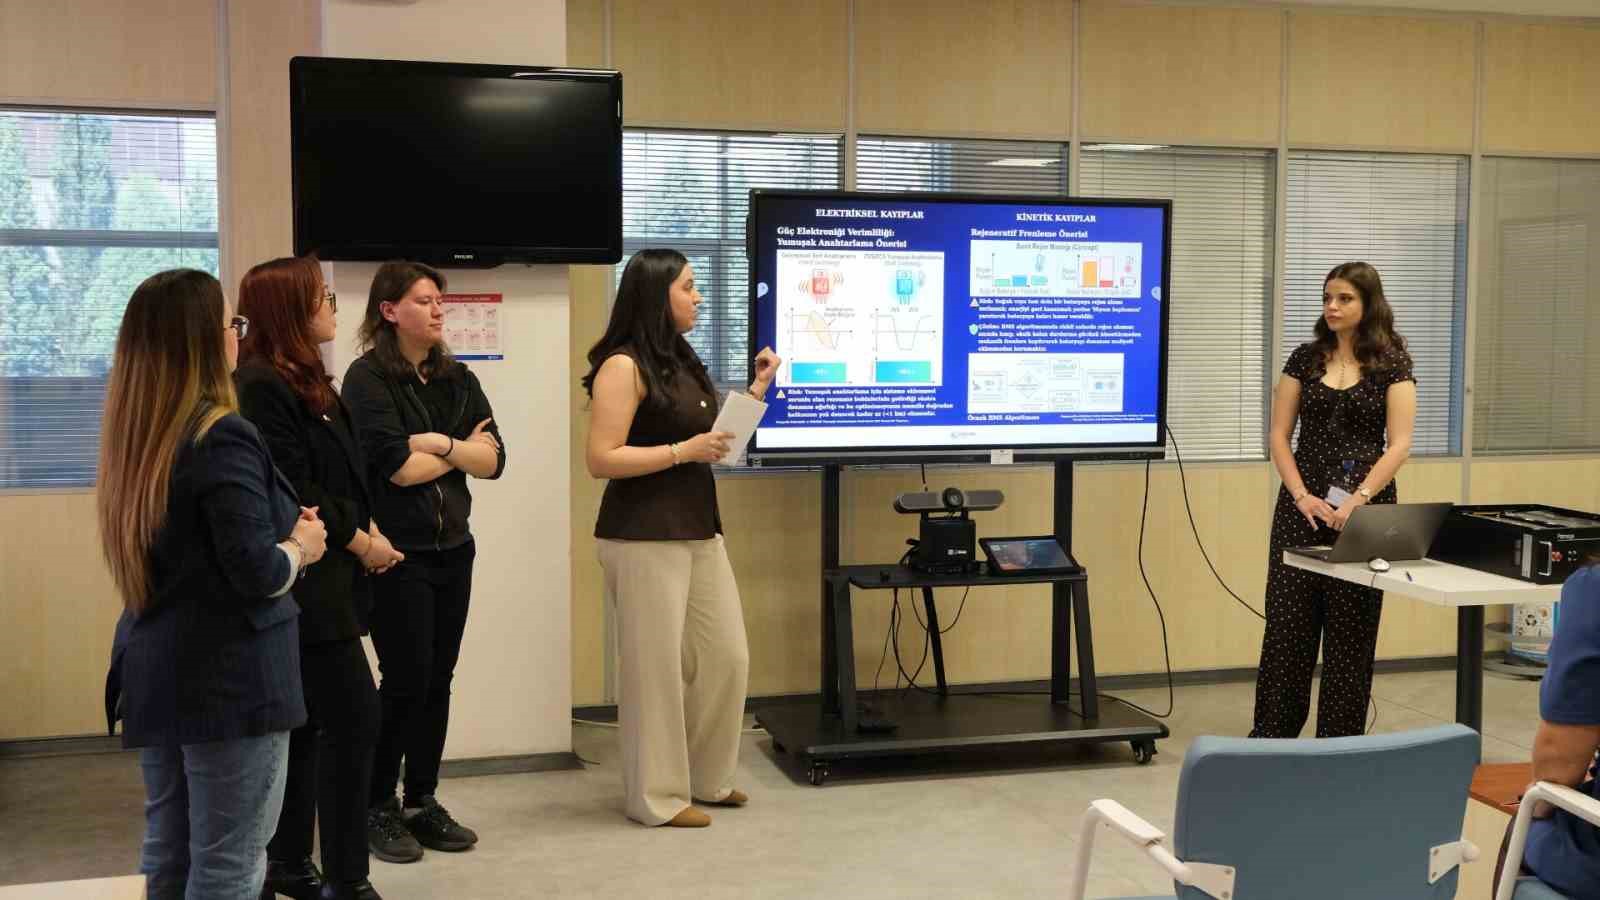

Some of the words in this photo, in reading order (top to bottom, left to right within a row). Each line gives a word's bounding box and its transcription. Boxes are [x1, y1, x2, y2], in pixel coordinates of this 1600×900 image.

[816, 209, 878, 218] ELEKTRİKSEL
[880, 210, 924, 219] KAYIPLAR
[1016, 213, 1053, 222] KİNETİK
[1055, 214, 1096, 223] KAYIPLAR
[777, 227, 794, 236] Güç
[797, 227, 845, 237] Elektroniği
[777, 238, 816, 247] Yumuşak
